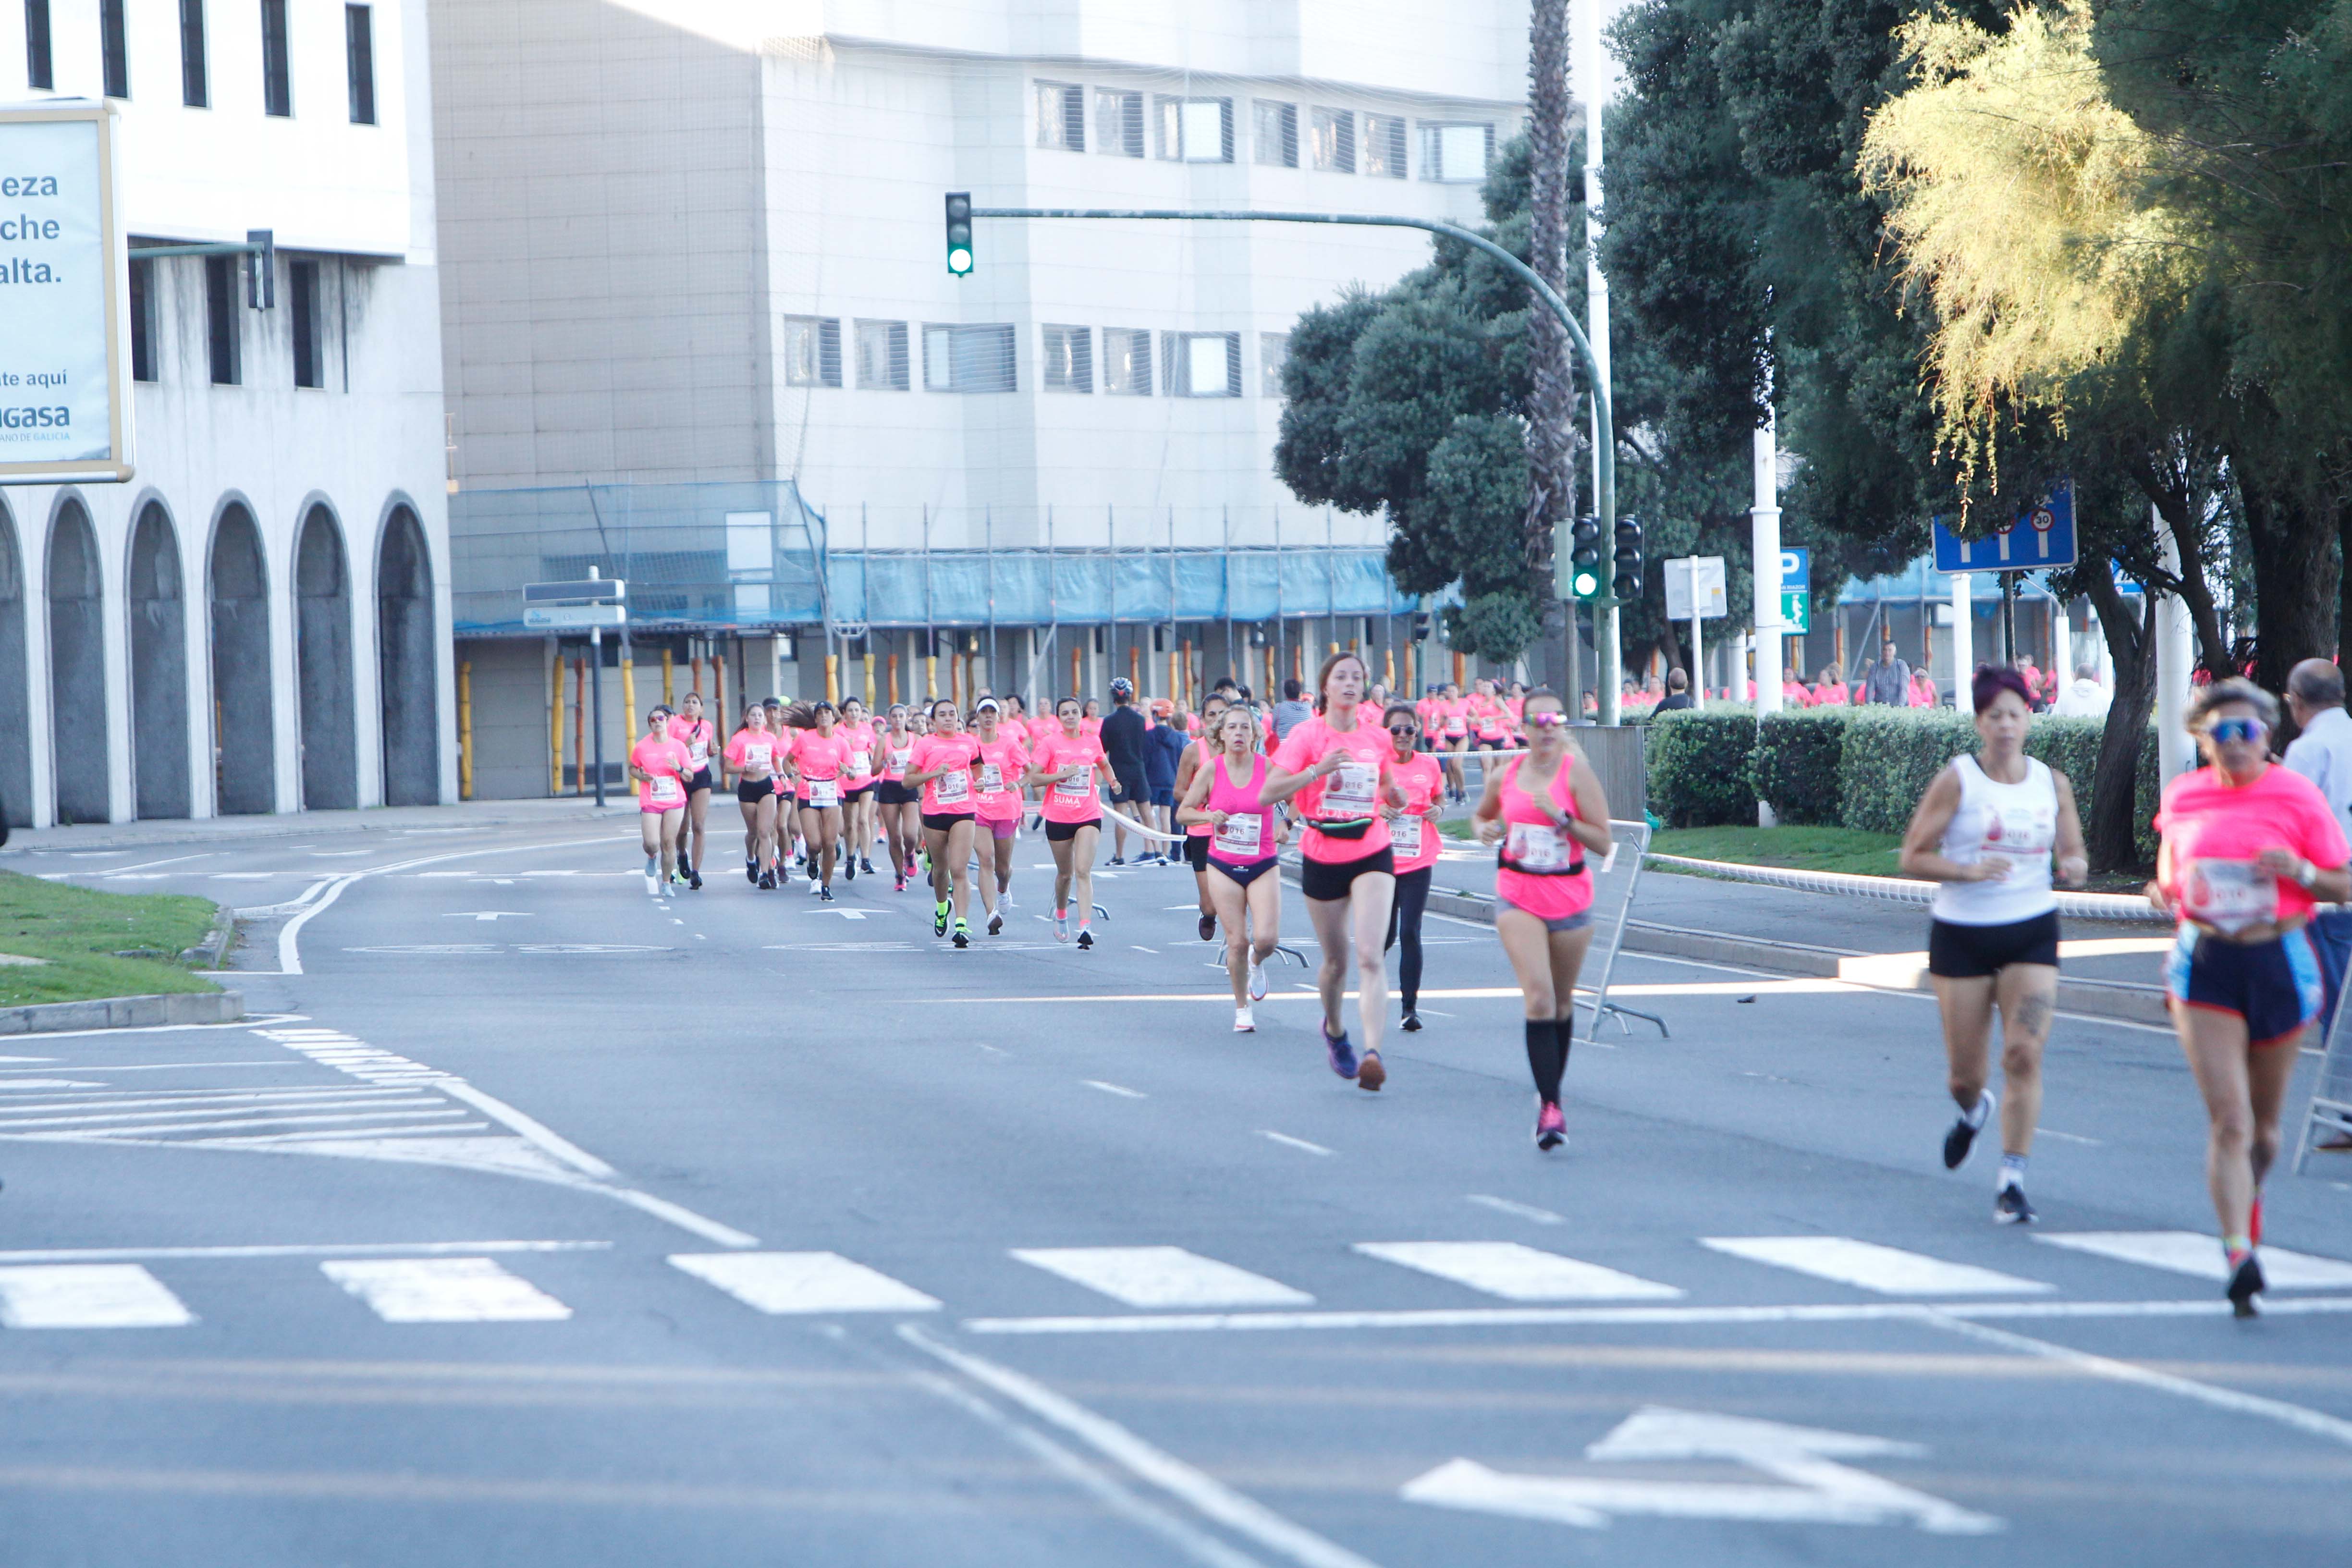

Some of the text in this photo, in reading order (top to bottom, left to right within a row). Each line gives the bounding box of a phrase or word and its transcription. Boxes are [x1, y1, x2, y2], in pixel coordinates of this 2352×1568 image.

[0, 213, 60, 240] che
[0, 369, 67, 388] te aquí
[20, 433, 31, 441] DE
[33, 432, 70, 441] GALICIA
[2036, 515, 2049, 524] 30
[1780, 552, 1800, 584] P
[1054, 795, 1080, 805] SUMA
[1229, 826, 1245, 834] 016
